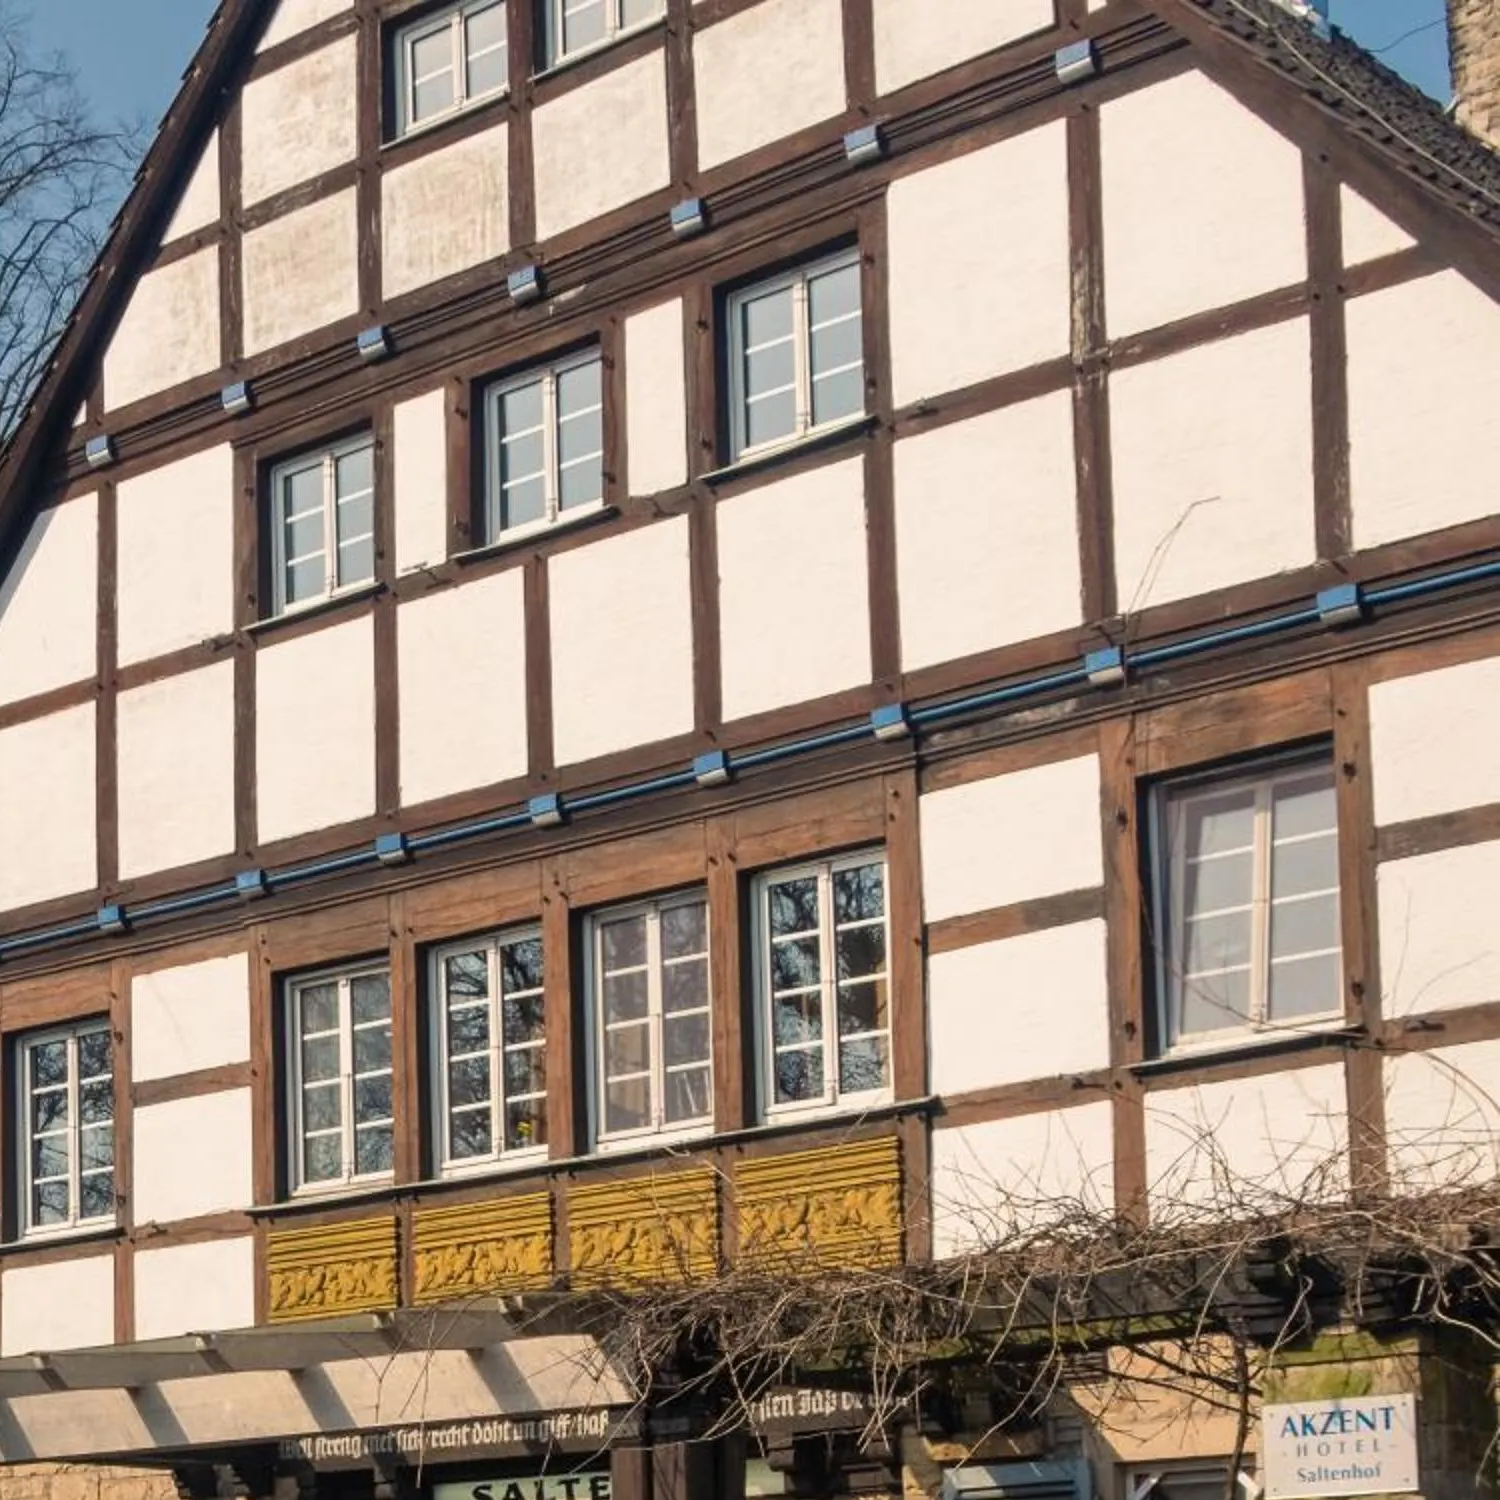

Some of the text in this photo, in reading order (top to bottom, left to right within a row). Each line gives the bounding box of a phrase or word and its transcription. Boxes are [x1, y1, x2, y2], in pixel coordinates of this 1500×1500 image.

[1281, 1405, 1394, 1438] AKZENT
[1296, 1438, 1382, 1457] HOTEL
[1296, 1462, 1381, 1483] Saltenhof
